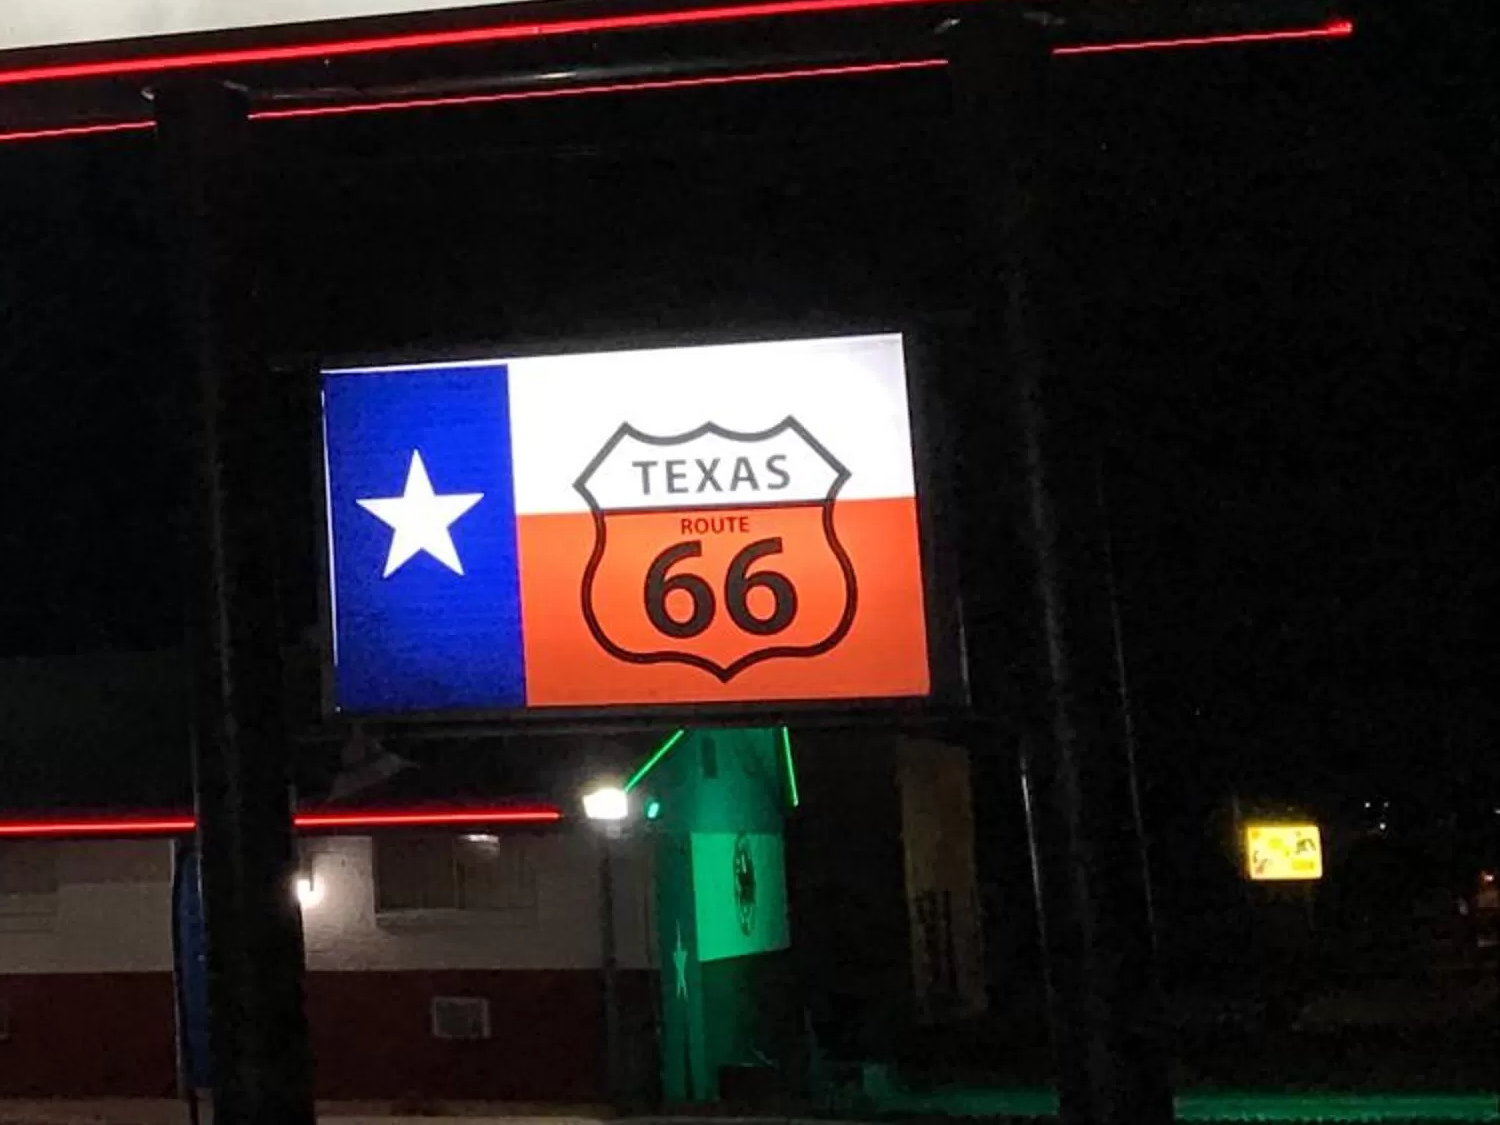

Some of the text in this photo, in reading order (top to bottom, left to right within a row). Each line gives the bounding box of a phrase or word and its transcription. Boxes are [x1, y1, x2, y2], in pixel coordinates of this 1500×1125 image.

[631, 454, 791, 496] TEXAS
[680, 516, 750, 536] ROUTE
[643, 537, 798, 640] 66
